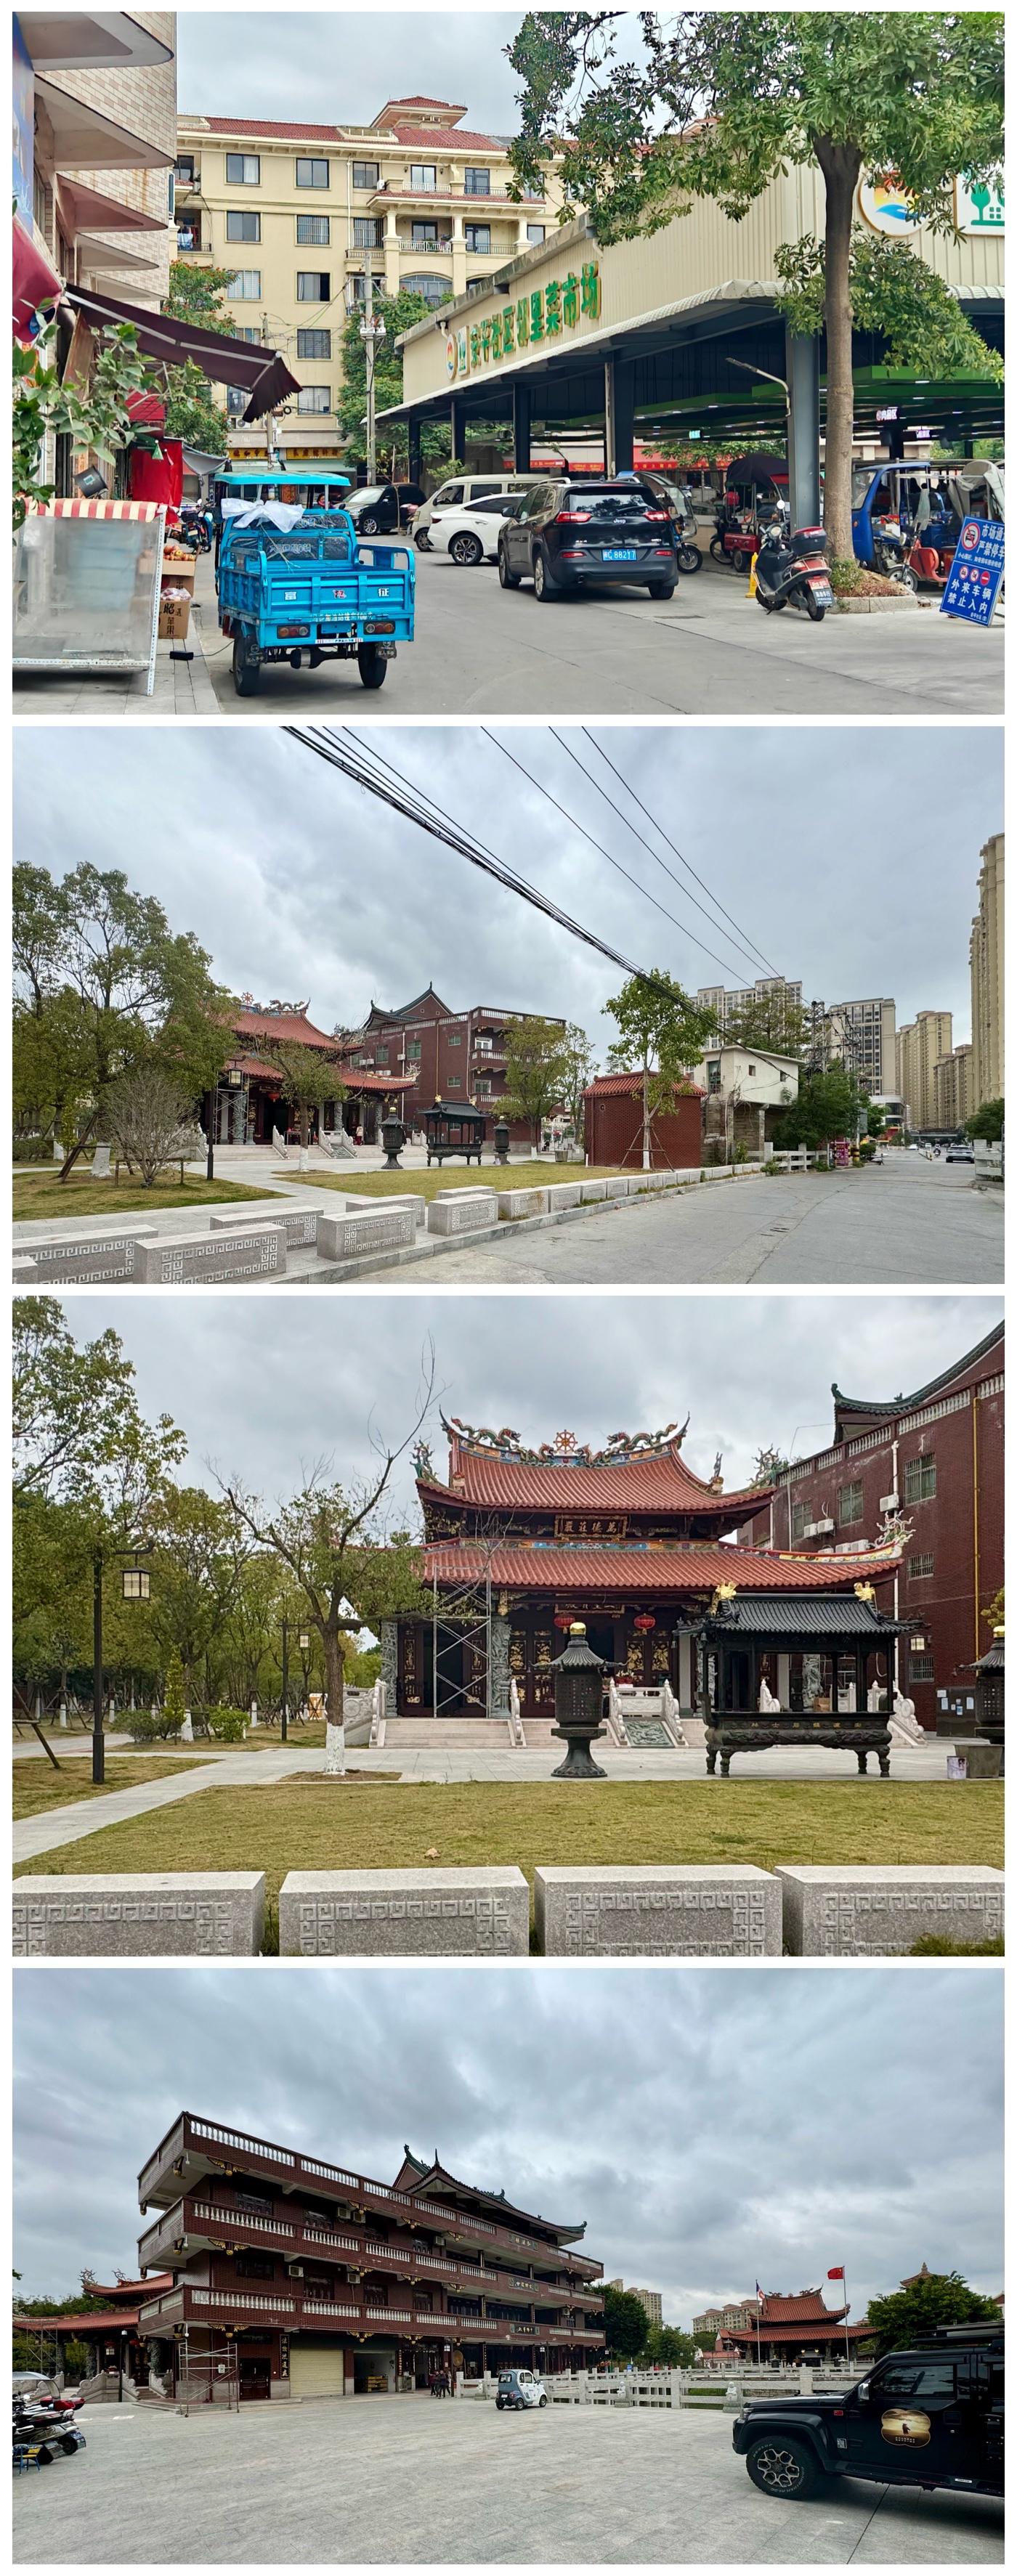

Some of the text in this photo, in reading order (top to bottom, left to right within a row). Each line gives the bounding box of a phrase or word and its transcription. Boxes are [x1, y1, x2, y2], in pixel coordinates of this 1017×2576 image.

[470, 260, 602, 367] 安平社区邻里菜市场
[981, 524, 1005, 543] 市场通
[976, 540, 1005, 562] 严禁停车
[951, 578, 992, 601] 外来车辆
[947, 592, 988, 614] 禁止入内
